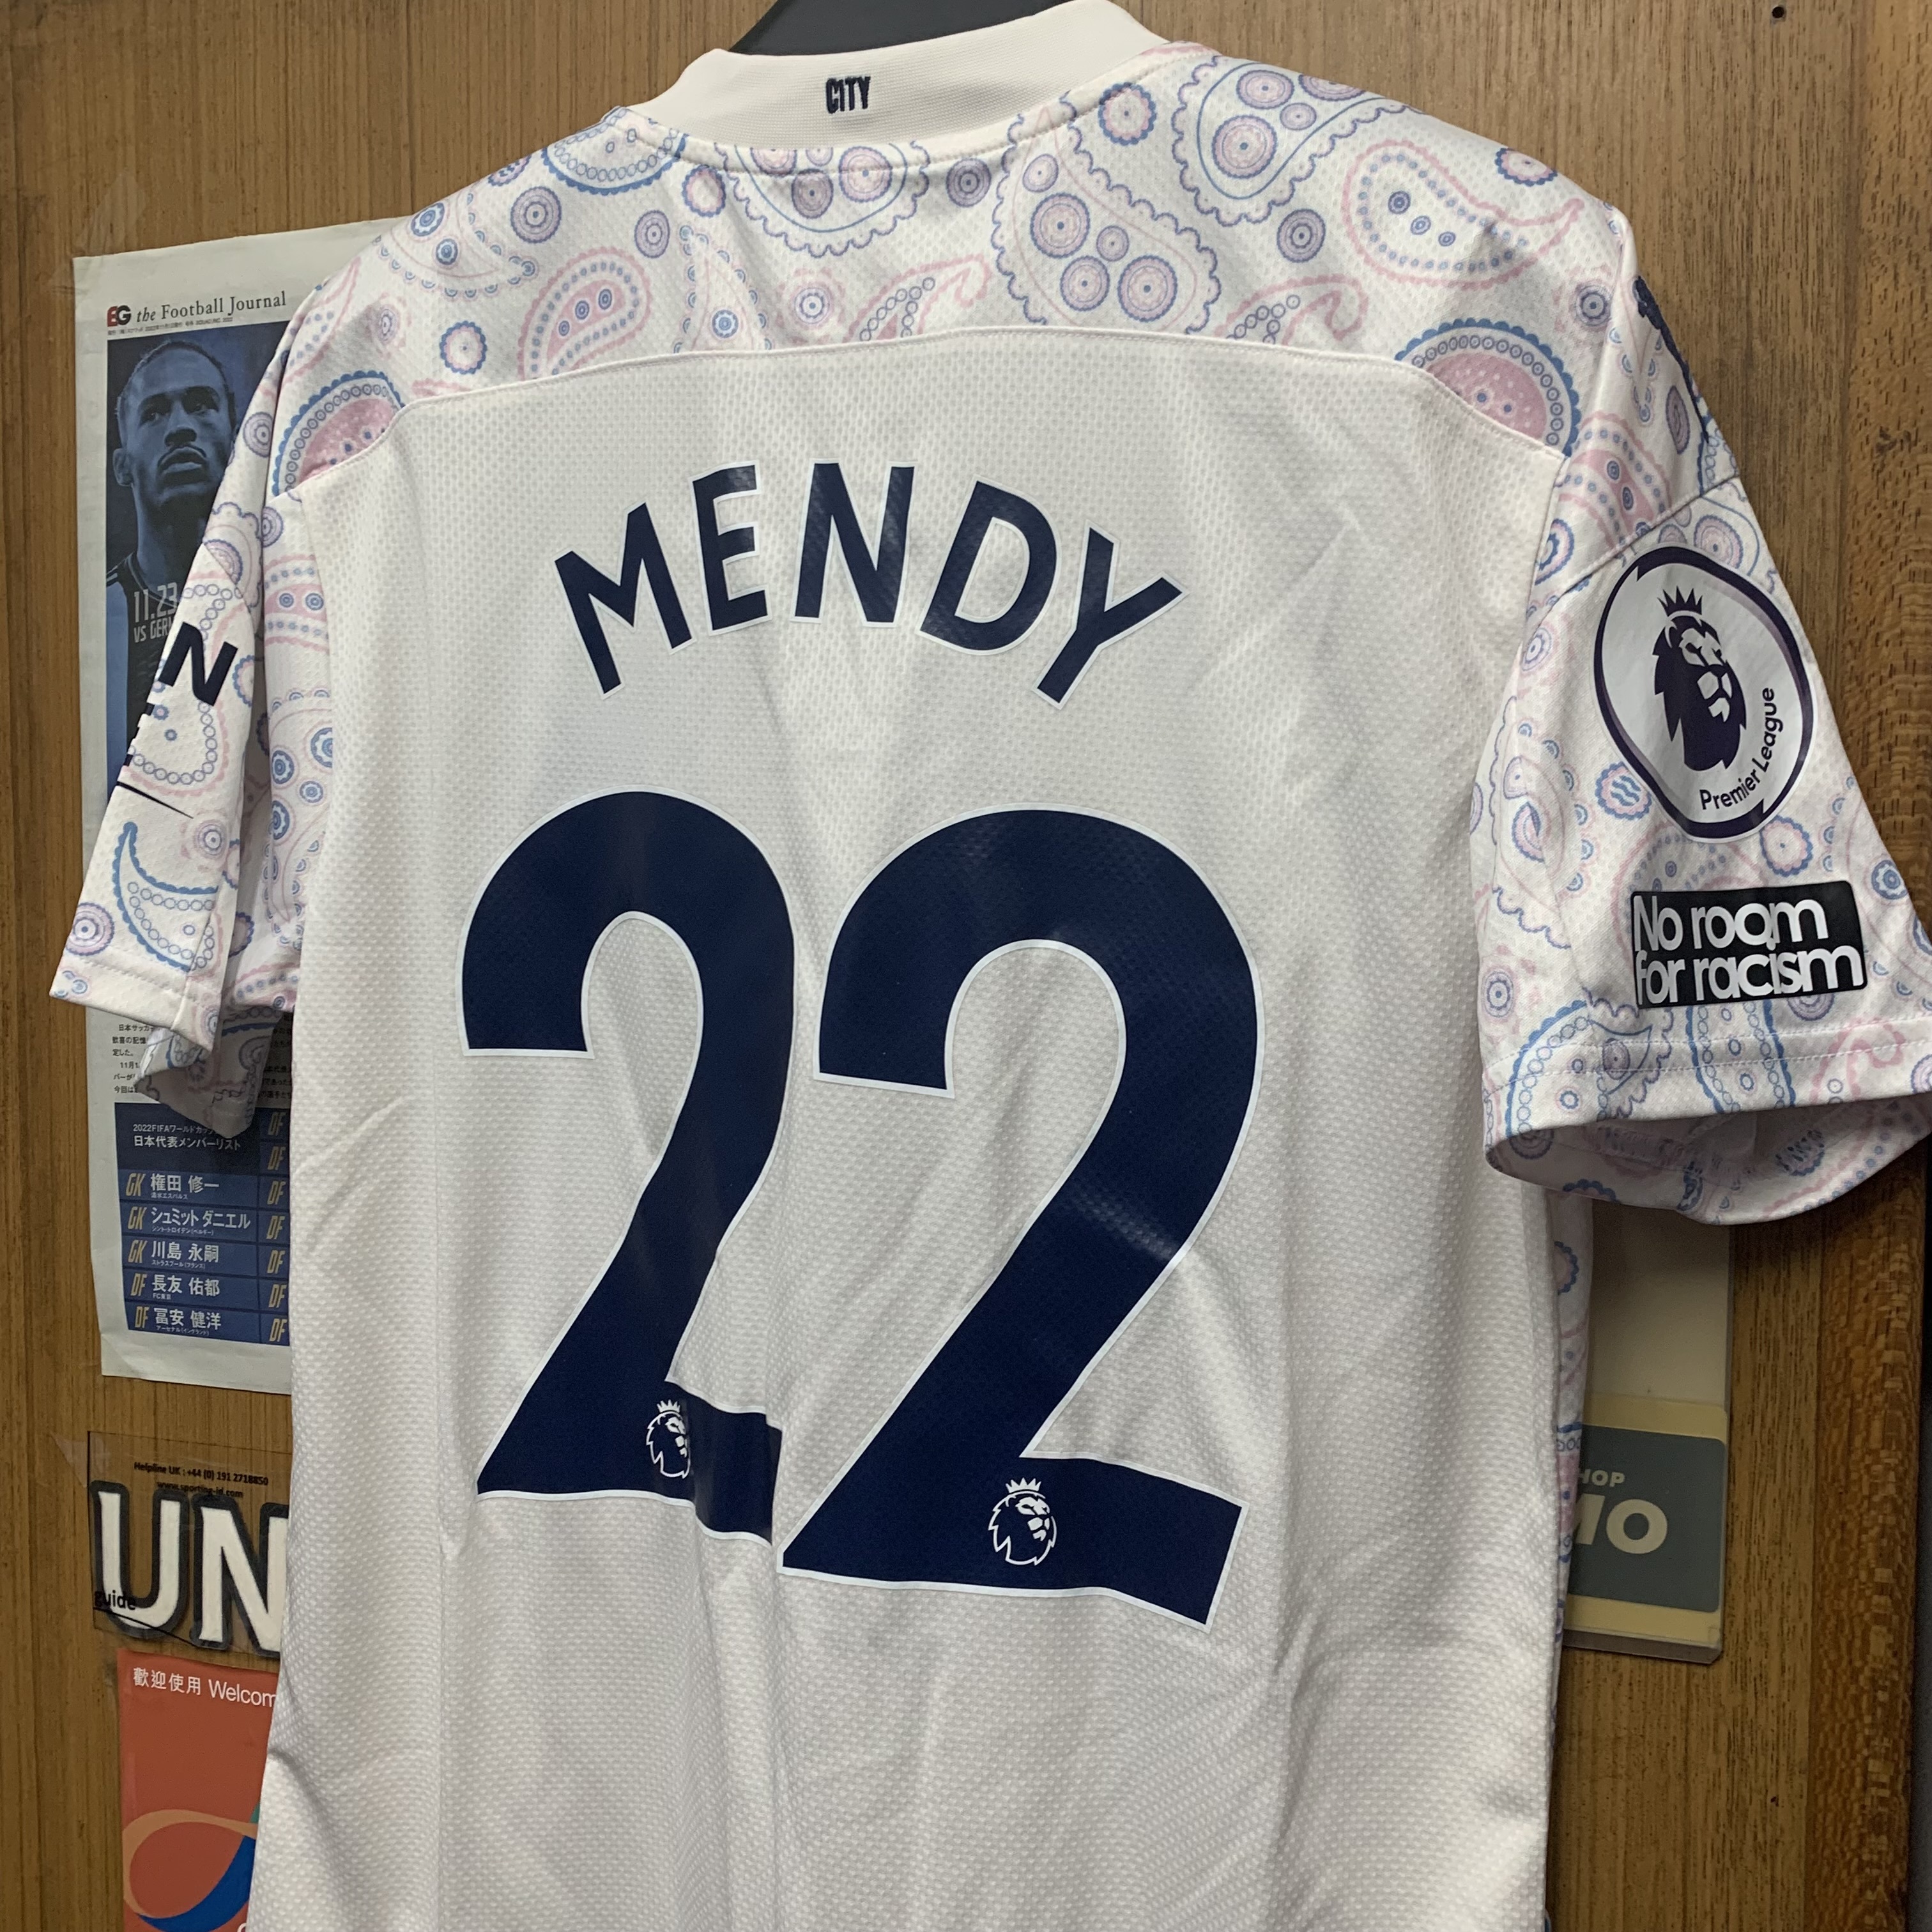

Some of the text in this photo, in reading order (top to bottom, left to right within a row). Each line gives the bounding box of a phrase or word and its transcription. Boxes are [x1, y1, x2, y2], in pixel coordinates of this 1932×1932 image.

[825, 75, 871, 114] CITY
[136, 307, 156, 323] the
[161, 298, 224, 320] Football
[228, 290, 287, 316] Journal
[553, 461, 1186, 707] MENDY
[134, 582, 178, 623] 11.23
[134, 625, 147, 643] VS
[1699, 687, 1784, 810] Premier League
[1634, 895, 1828, 951] No room
[1636, 945, 1864, 1005] for racism
[268, 1112, 287, 1135] DF
[134, 1135, 241, 1150] 日本代表メンバーリスト
[267, 1146, 286, 1170] DF
[126, 1173, 146, 1197] GK
[150, 1173, 219, 1193] 権田 修一
[267, 1180, 286, 1205] DF
[128, 1206, 147, 1230] GK
[151, 1207, 250, 1229] シュミット ダニエル
[457, 787, 1262, 1631] 22
[266, 1215, 285, 1239] DF
[128, 1239, 148, 1263] GK
[151, 1241, 219, 1263] 川島 永嗣
[266, 1250, 286, 1274] DF
[130, 1273, 148, 1296] DF
[152, 1274, 220, 1297] 長友 佑都
[268, 1284, 287, 1308] DF
[135, 1306, 150, 1328] DF
[153, 1307, 222, 1330] 冨安 健洋
[269, 1318, 288, 1342] DF
[134, 1461, 167, 1473] Helpline
[169, 1466, 181, 1475] UK
[203, 1469, 215, 1481] (0)
[217, 1471, 231, 1482] 191
[133, 1667, 201, 1695] 歡迎使用
